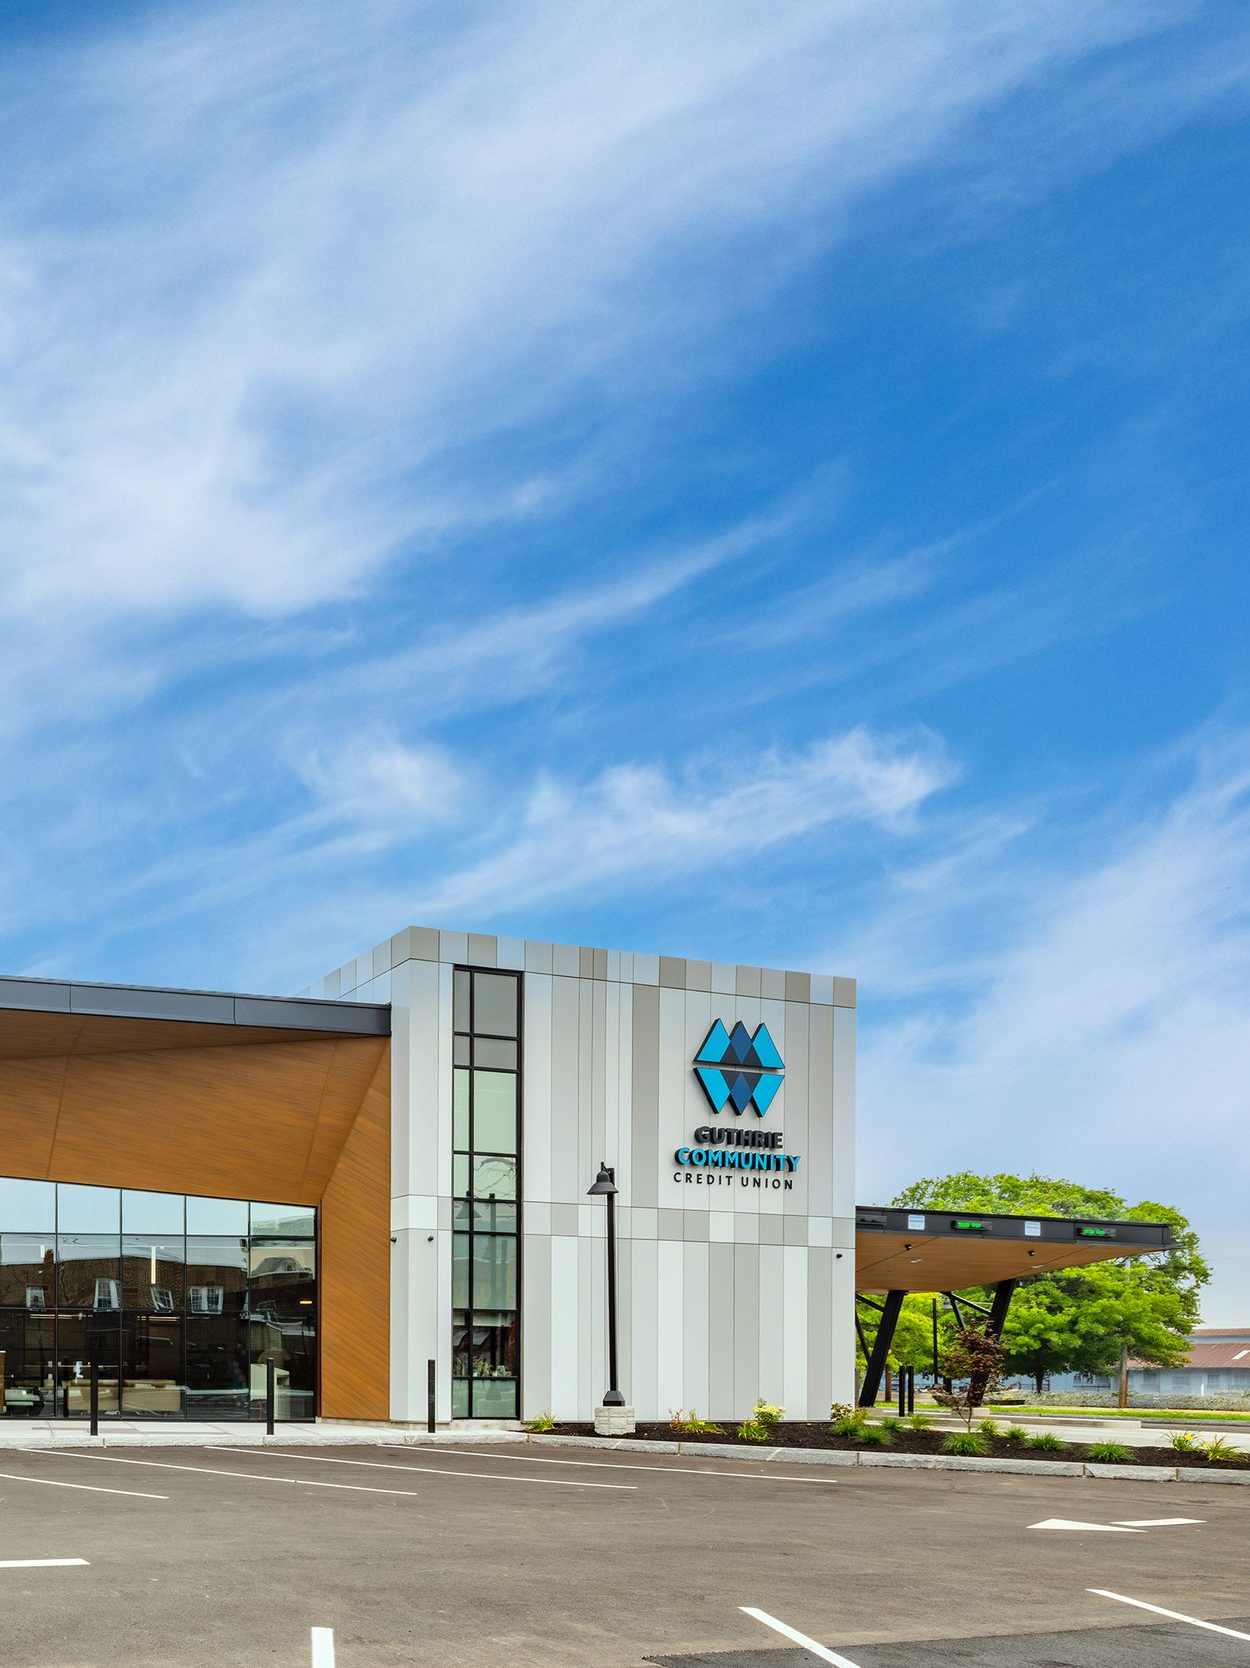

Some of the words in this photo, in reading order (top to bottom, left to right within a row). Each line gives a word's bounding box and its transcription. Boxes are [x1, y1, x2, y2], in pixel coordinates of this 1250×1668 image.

[694, 1126, 783, 1149] GUTHRIE
[675, 1147, 801, 1172] COMMUNITY
[674, 1172, 733, 1186] CREDIT
[741, 1176, 793, 1190] UNION
